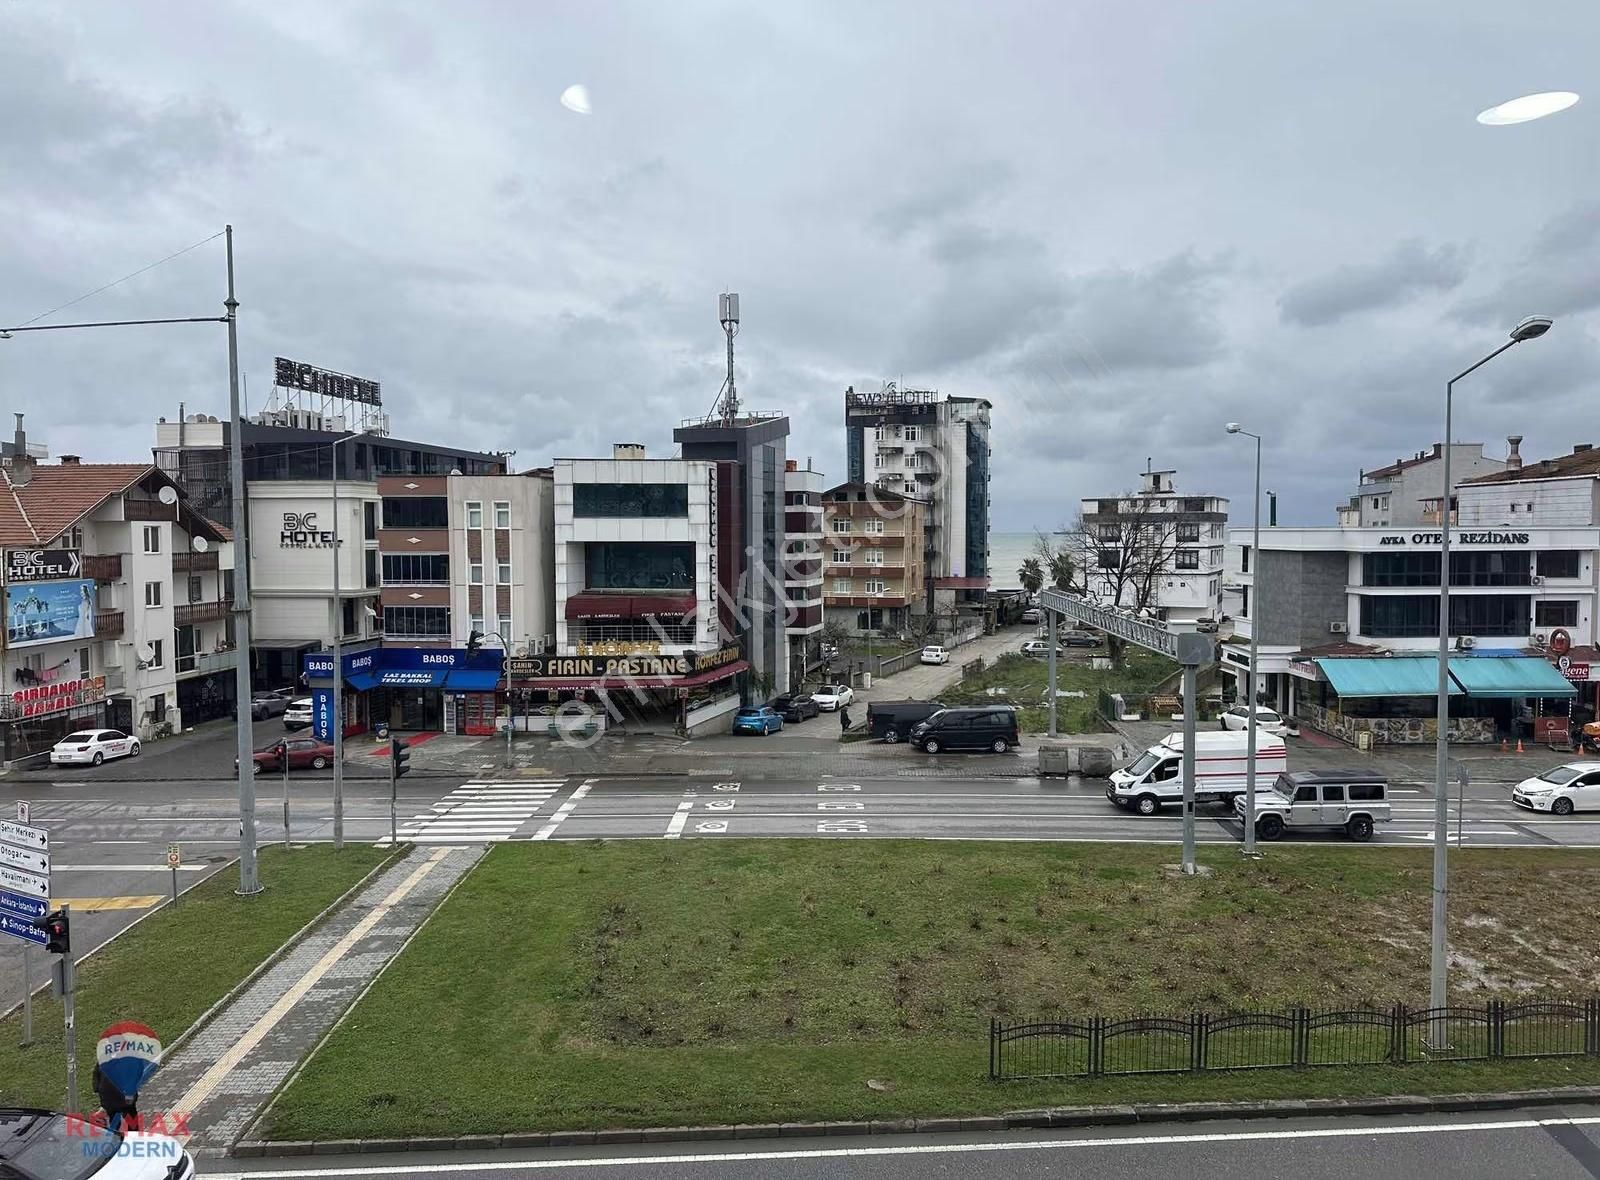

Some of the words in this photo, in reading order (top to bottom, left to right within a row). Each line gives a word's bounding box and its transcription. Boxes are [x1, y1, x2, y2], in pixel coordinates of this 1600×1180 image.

[280, 531, 344, 543] HOTEL
[1380, 536, 1406, 544] AYKA
[1459, 531, 1529, 544] REZİDANS
[8, 564, 68, 576] HOTEL
[352, 656, 372, 668] BABOŞ
[423, 654, 455, 665] BABOŞ
[309, 662, 334, 670] BABO
[548, 659, 593, 675] FIRIN
[606, 658, 687, 675] PASTANE
[320, 694, 328, 738] BABOŞ
[1, 846, 22, 859] Otogar
[9, 919, 46, 938] Sinop-Bafra
